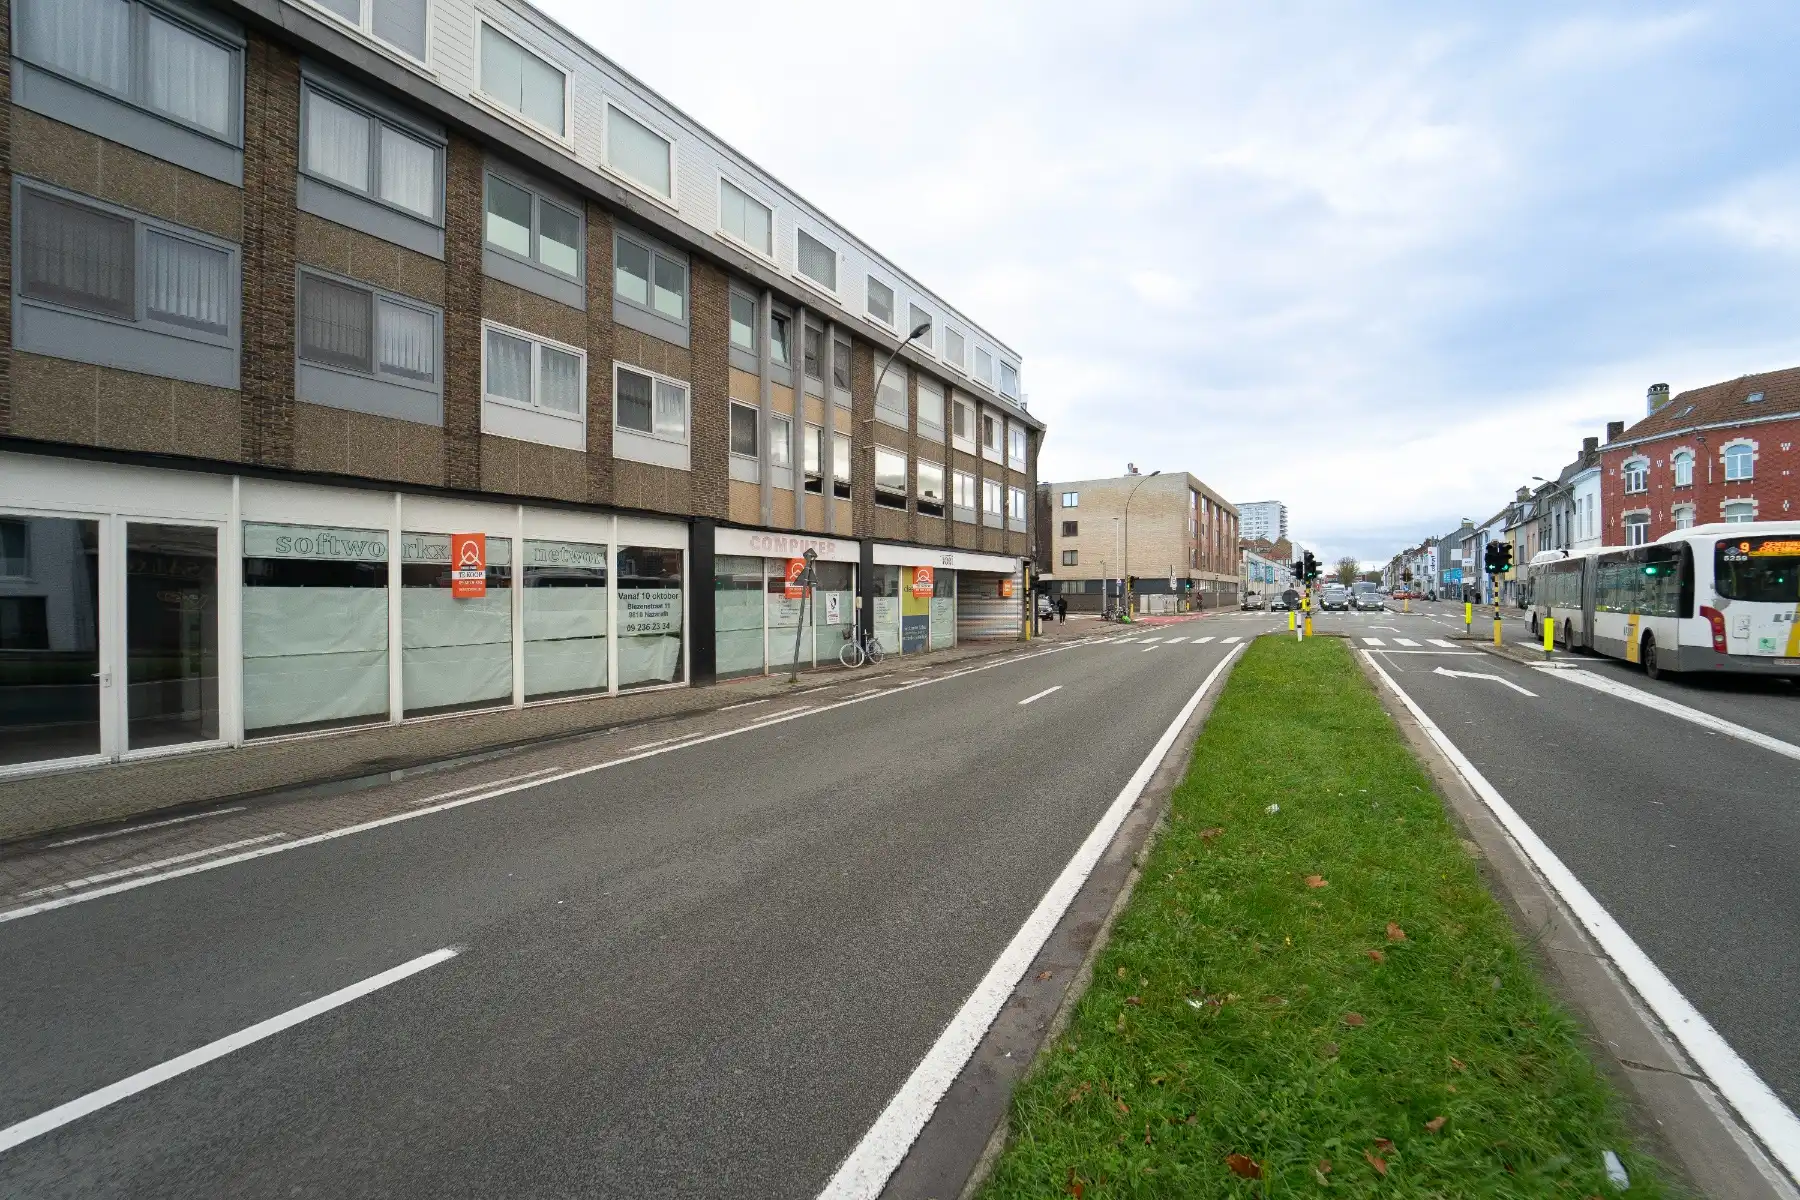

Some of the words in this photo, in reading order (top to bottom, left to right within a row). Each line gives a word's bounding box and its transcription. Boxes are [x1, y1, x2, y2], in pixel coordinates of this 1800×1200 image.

[1740, 542, 1750, 553] 9
[618, 592, 640, 600] Vanaf
[642, 592, 651, 600] 10
[652, 591, 679, 600] oktober
[637, 623, 651, 631] 236
